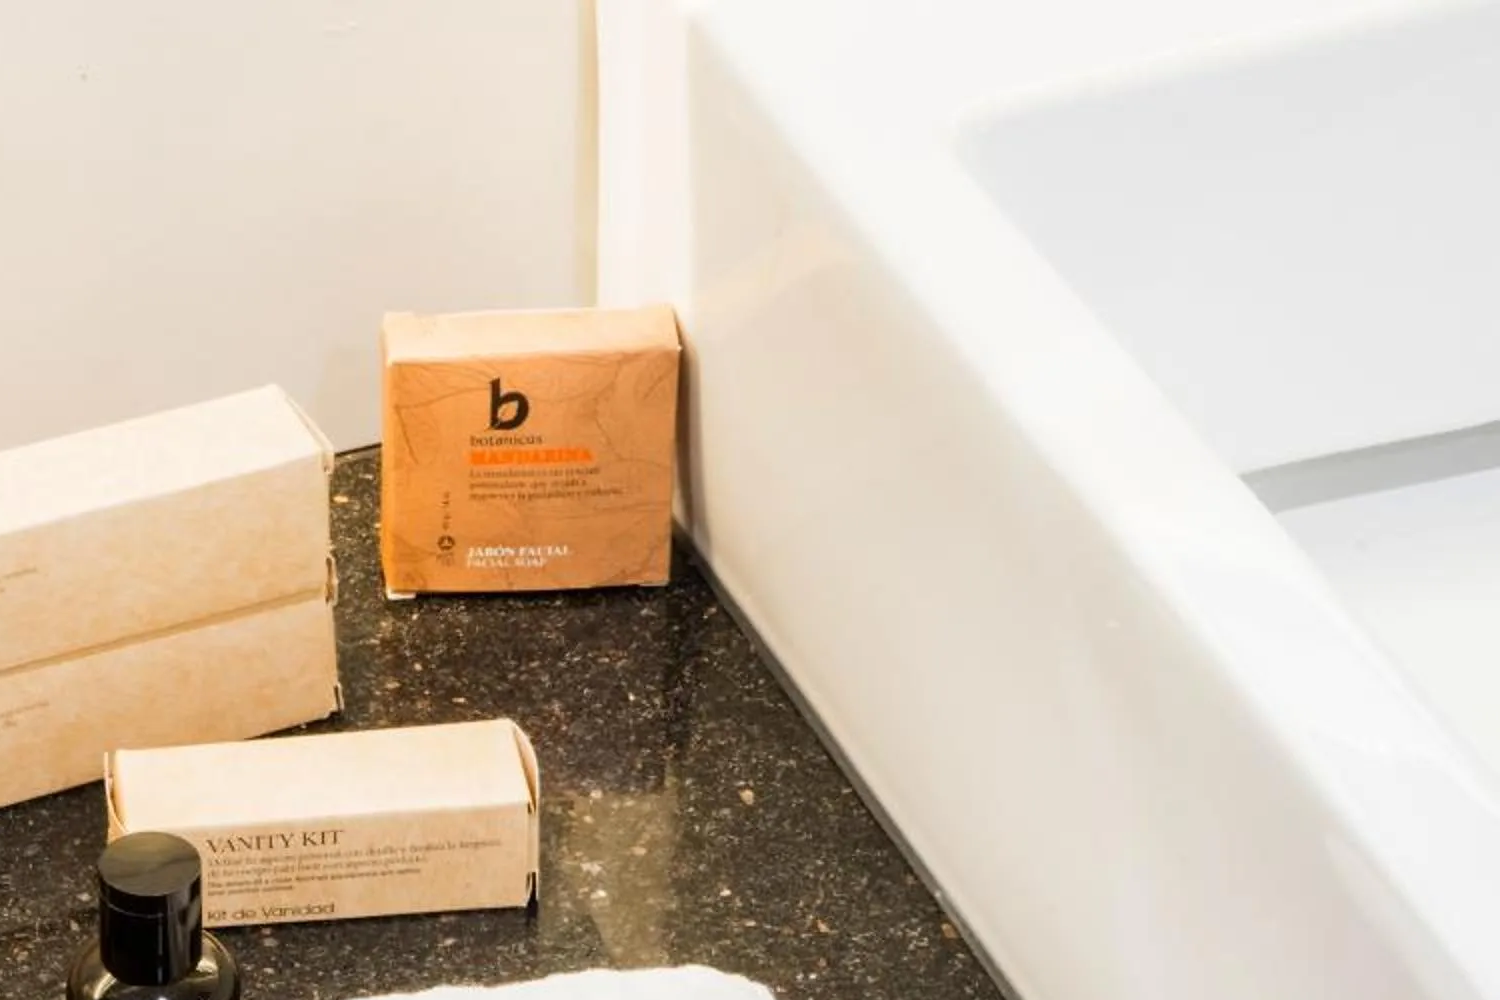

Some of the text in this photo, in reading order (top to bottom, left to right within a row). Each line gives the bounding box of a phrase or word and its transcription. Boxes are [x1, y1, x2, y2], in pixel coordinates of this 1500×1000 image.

[487, 378, 529, 430] b
[470, 435, 542, 447] botanicus
[207, 830, 343, 853] VANITY KIT
[233, 906, 256, 918] de
[262, 902, 334, 918] Vanidad
